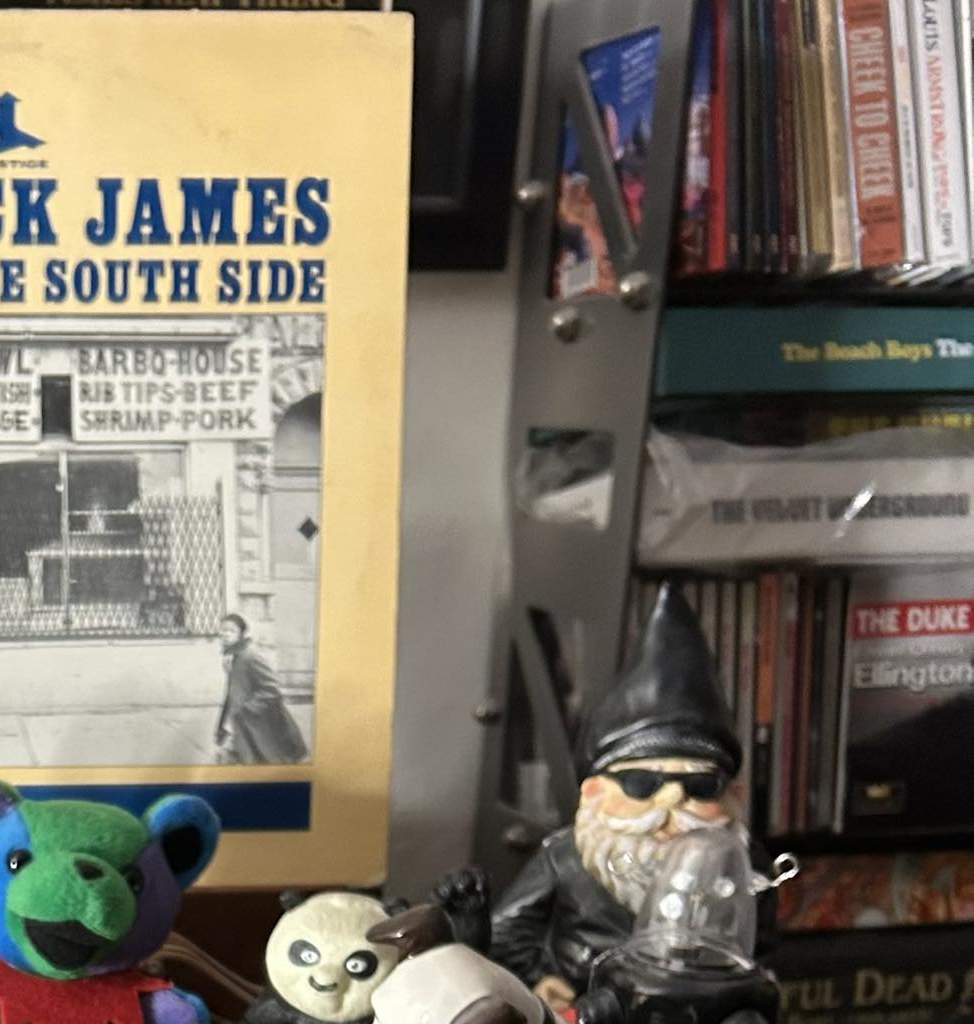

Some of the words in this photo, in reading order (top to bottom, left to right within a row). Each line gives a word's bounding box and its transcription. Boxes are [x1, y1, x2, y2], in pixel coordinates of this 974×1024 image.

[848, 26, 888, 96] CHEEK
[854, 98, 890, 129] TO
[857, 131, 895, 200] CHEEK
[85, 177, 330, 247] JAMES
[44, 258, 202, 304] SOUTH
[218, 258, 327, 304] SIDE
[781, 341, 820, 363] The
[823, 340, 883, 361] Beach
[885, 338, 934, 363] Boys
[856, 607, 901, 633] THE
[907, 604, 972, 632] DUKE
[854, 660, 974, 692] Ellington
[853, 967, 955, 1006] DEAD
